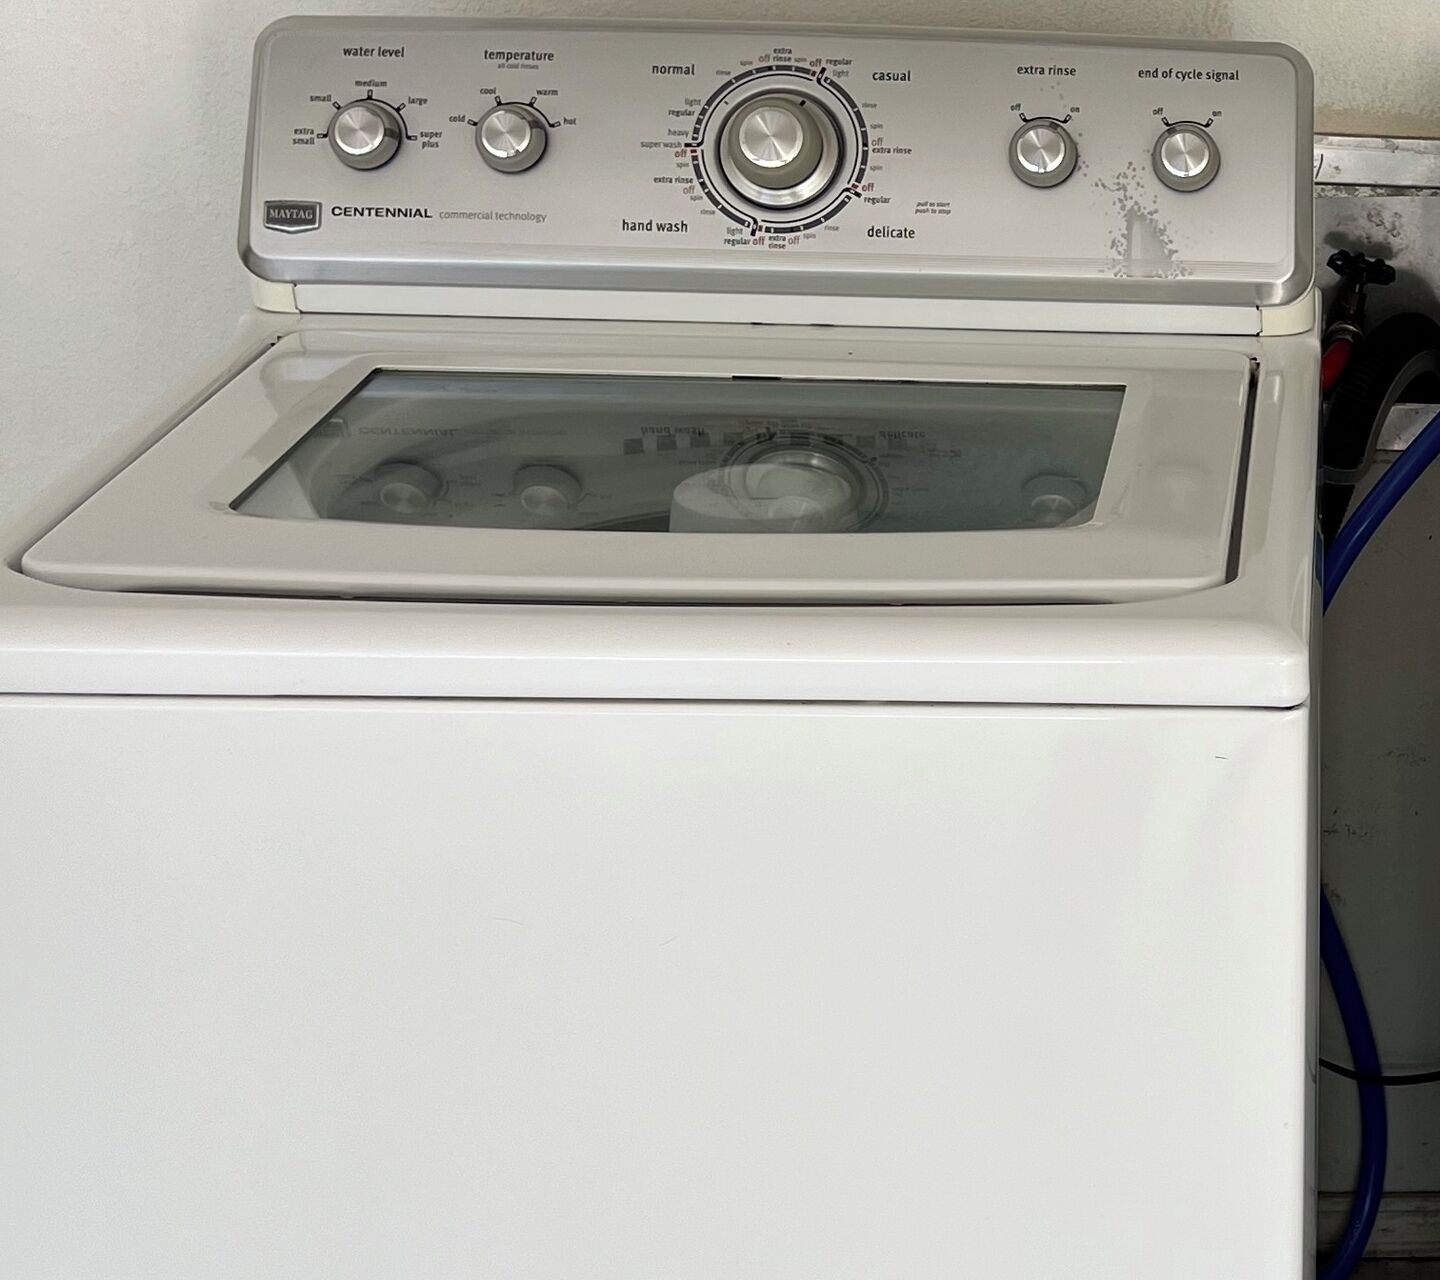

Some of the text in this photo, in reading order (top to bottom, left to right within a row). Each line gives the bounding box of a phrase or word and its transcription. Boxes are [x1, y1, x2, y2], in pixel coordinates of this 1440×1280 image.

[343, 46, 405, 58] water level
[484, 49, 554, 62] temperature
[758, 54, 770, 62] off
[810, 59, 822, 67] off
[825, 58, 853, 66] regular
[652, 64, 695, 76] normal
[1017, 65, 1076, 76] extra rinse
[872, 70, 911, 82] casual
[1138, 67, 1240, 83] end of cycle signal
[355, 79, 387, 87] medium
[480, 87, 497, 95] cool
[536, 88, 559, 96] warm
[408, 96, 428, 105] large
[1010, 103, 1021, 111] off
[1152, 107, 1163, 115] off
[668, 109, 695, 117] regular
[449, 115, 466, 123] cold
[563, 117, 576, 125] hot
[294, 128, 314, 136] extra
[420, 131, 442, 139] super
[668, 129, 689, 137] heavy
[422, 140, 439, 148] plus
[871, 137, 884, 146] off
[675, 149, 687, 158] off
[893, 146, 912, 154] rinse
[653, 176, 694, 184] extra rinse
[683, 186, 695, 194] off
[862, 183, 875, 192] off
[864, 196, 891, 205] regular
[268, 207, 314, 221] MAYTAG
[331, 205, 548, 223] CENTENNIAL commercial technology
[622, 219, 688, 233] hand wash
[867, 226, 916, 238] delicate
[724, 236, 765, 246] regular off
[788, 235, 801, 245] off
